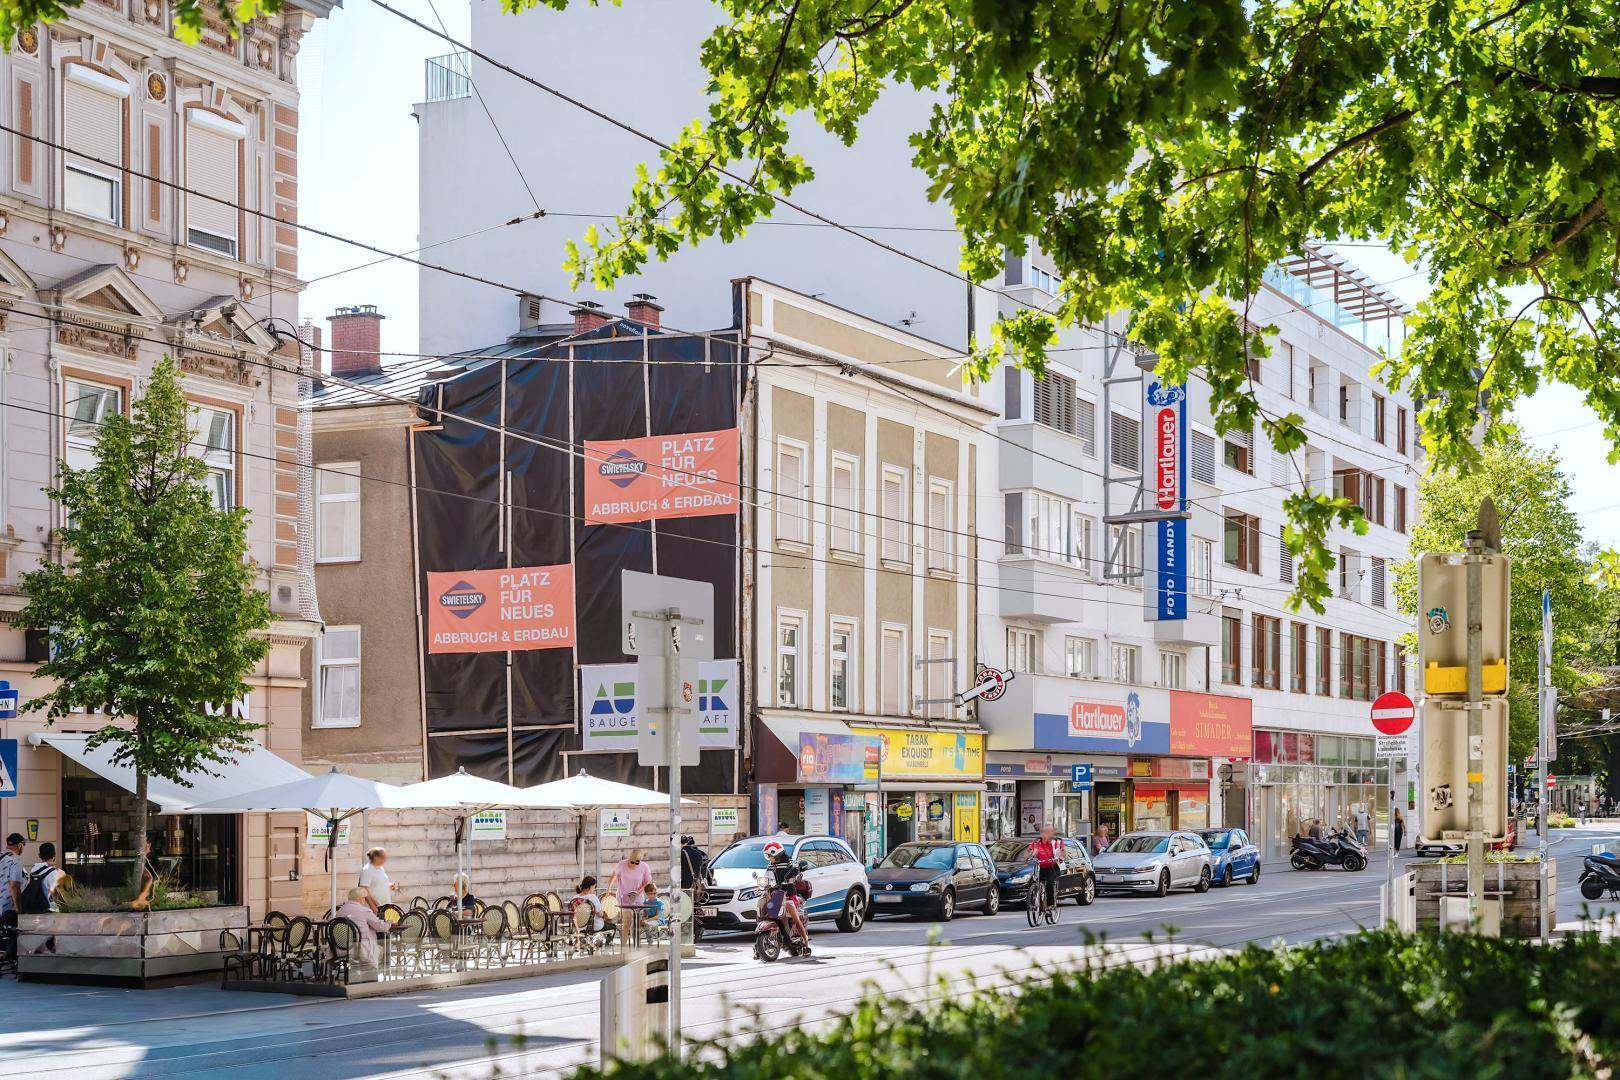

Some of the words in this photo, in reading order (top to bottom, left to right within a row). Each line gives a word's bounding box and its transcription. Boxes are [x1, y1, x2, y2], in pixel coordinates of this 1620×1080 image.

[661, 437, 715, 455] PLATZ
[661, 453, 695, 471] FÜR
[1158, 415, 1176, 502] Hartlauer
[601, 462, 645, 475] SWIETELSKY
[661, 469, 719, 488] NEUES
[591, 499, 658, 516] ABBRUCH
[661, 499, 671, 510] &
[674, 493, 733, 508] ERDBAU
[499, 572, 551, 588] PLATZ
[442, 593, 483, 606] SWIETELSKY
[500, 586, 532, 605] FÜR
[1166, 578, 1175, 616] FOTO
[500, 604, 555, 621] NEUES
[433, 632, 498, 645] ABBRUCH
[501, 631, 511, 642] &
[513, 626, 569, 642] ERDBAU
[977, 670, 998, 686] TABAK
[983, 680, 1004, 699] TRAFIK
[1075, 703, 1123, 731] Hartlauer
[905, 733, 929, 746] TABAK
[1195, 722, 1232, 740] SIMADER
[901, 746, 933, 759] EXQUISIT
[966, 747, 981, 758] TIME
[1075, 766, 1087, 781] P
